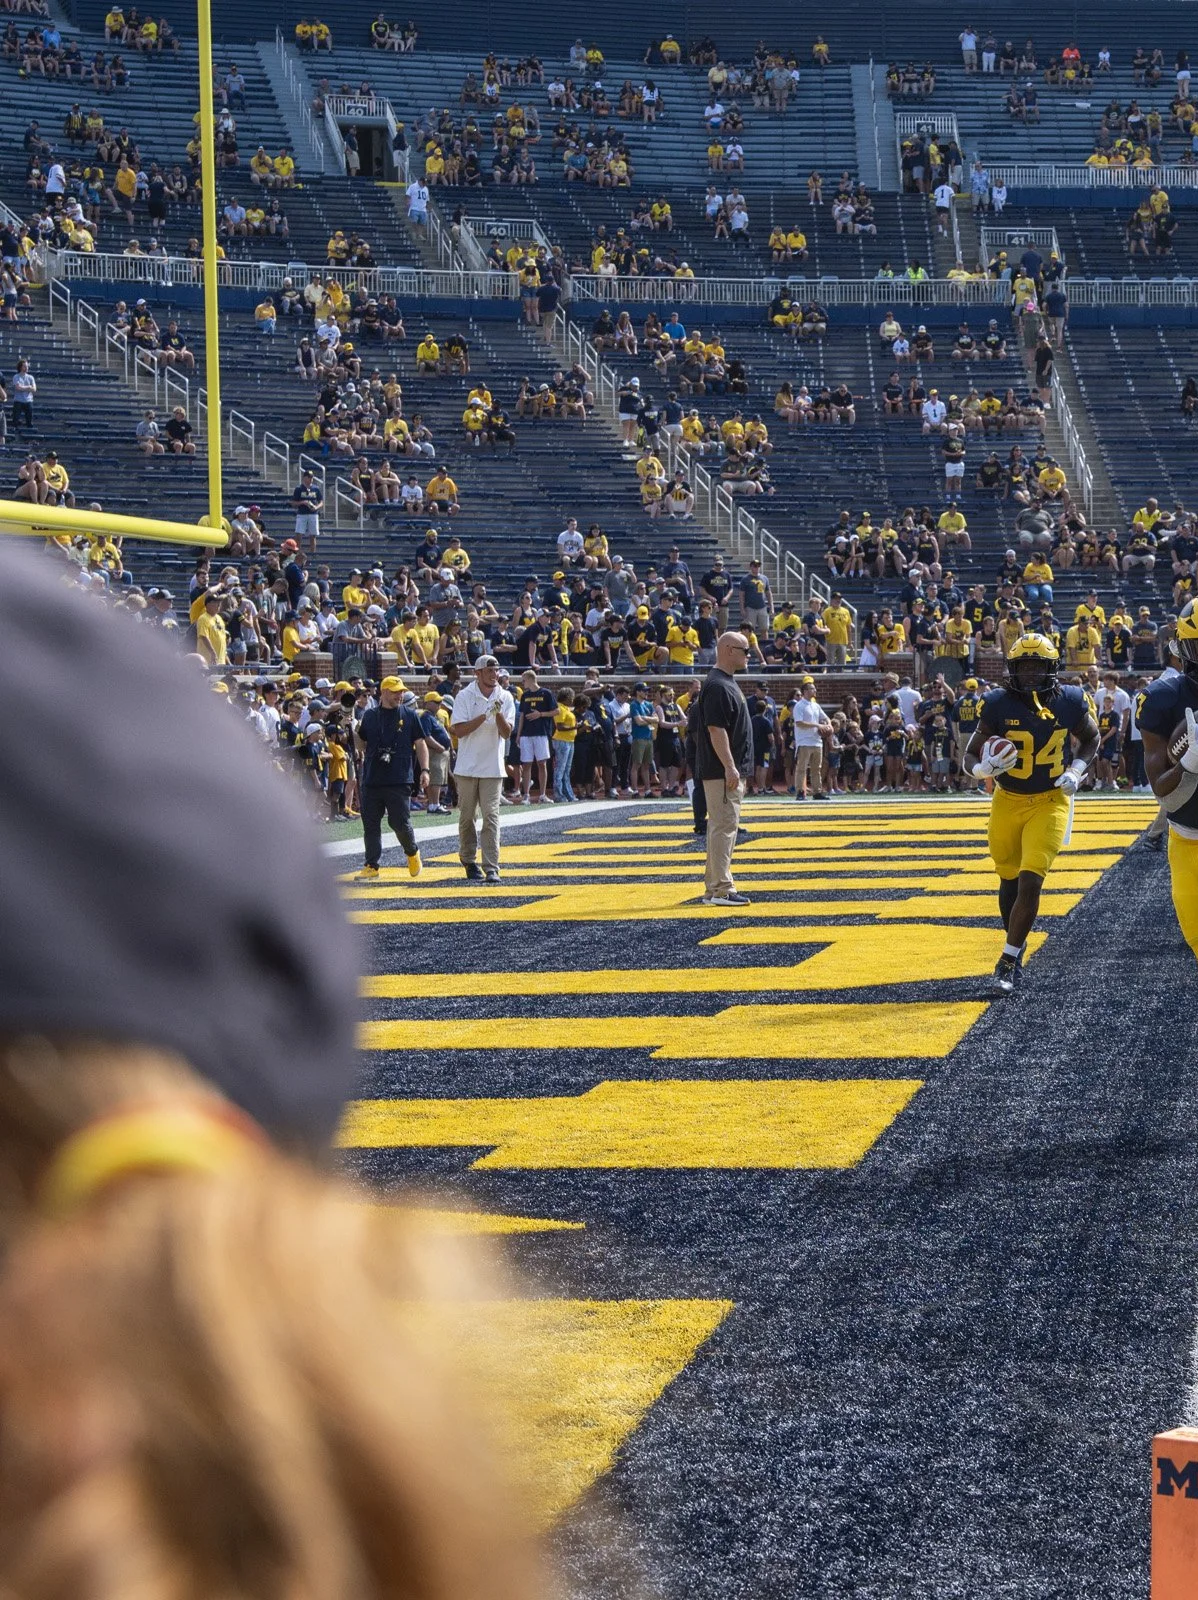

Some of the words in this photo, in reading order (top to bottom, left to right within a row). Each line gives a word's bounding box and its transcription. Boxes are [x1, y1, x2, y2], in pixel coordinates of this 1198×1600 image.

[920, 124, 932, 132] 41
[417, 190, 427, 200] 10
[489, 227, 506, 235] 40
[1011, 236, 1025, 245] 41
[560, 592, 570, 606] 6
[973, 608, 983, 621] 5
[666, 616, 675, 628] 2
[636, 632, 647, 642] 4
[887, 636, 894, 648] 2
[1113, 639, 1122, 653] 2
[1135, 692, 1147, 719] 7
[1102, 717, 1109, 727] M
[1005, 728, 1068, 779] 34
